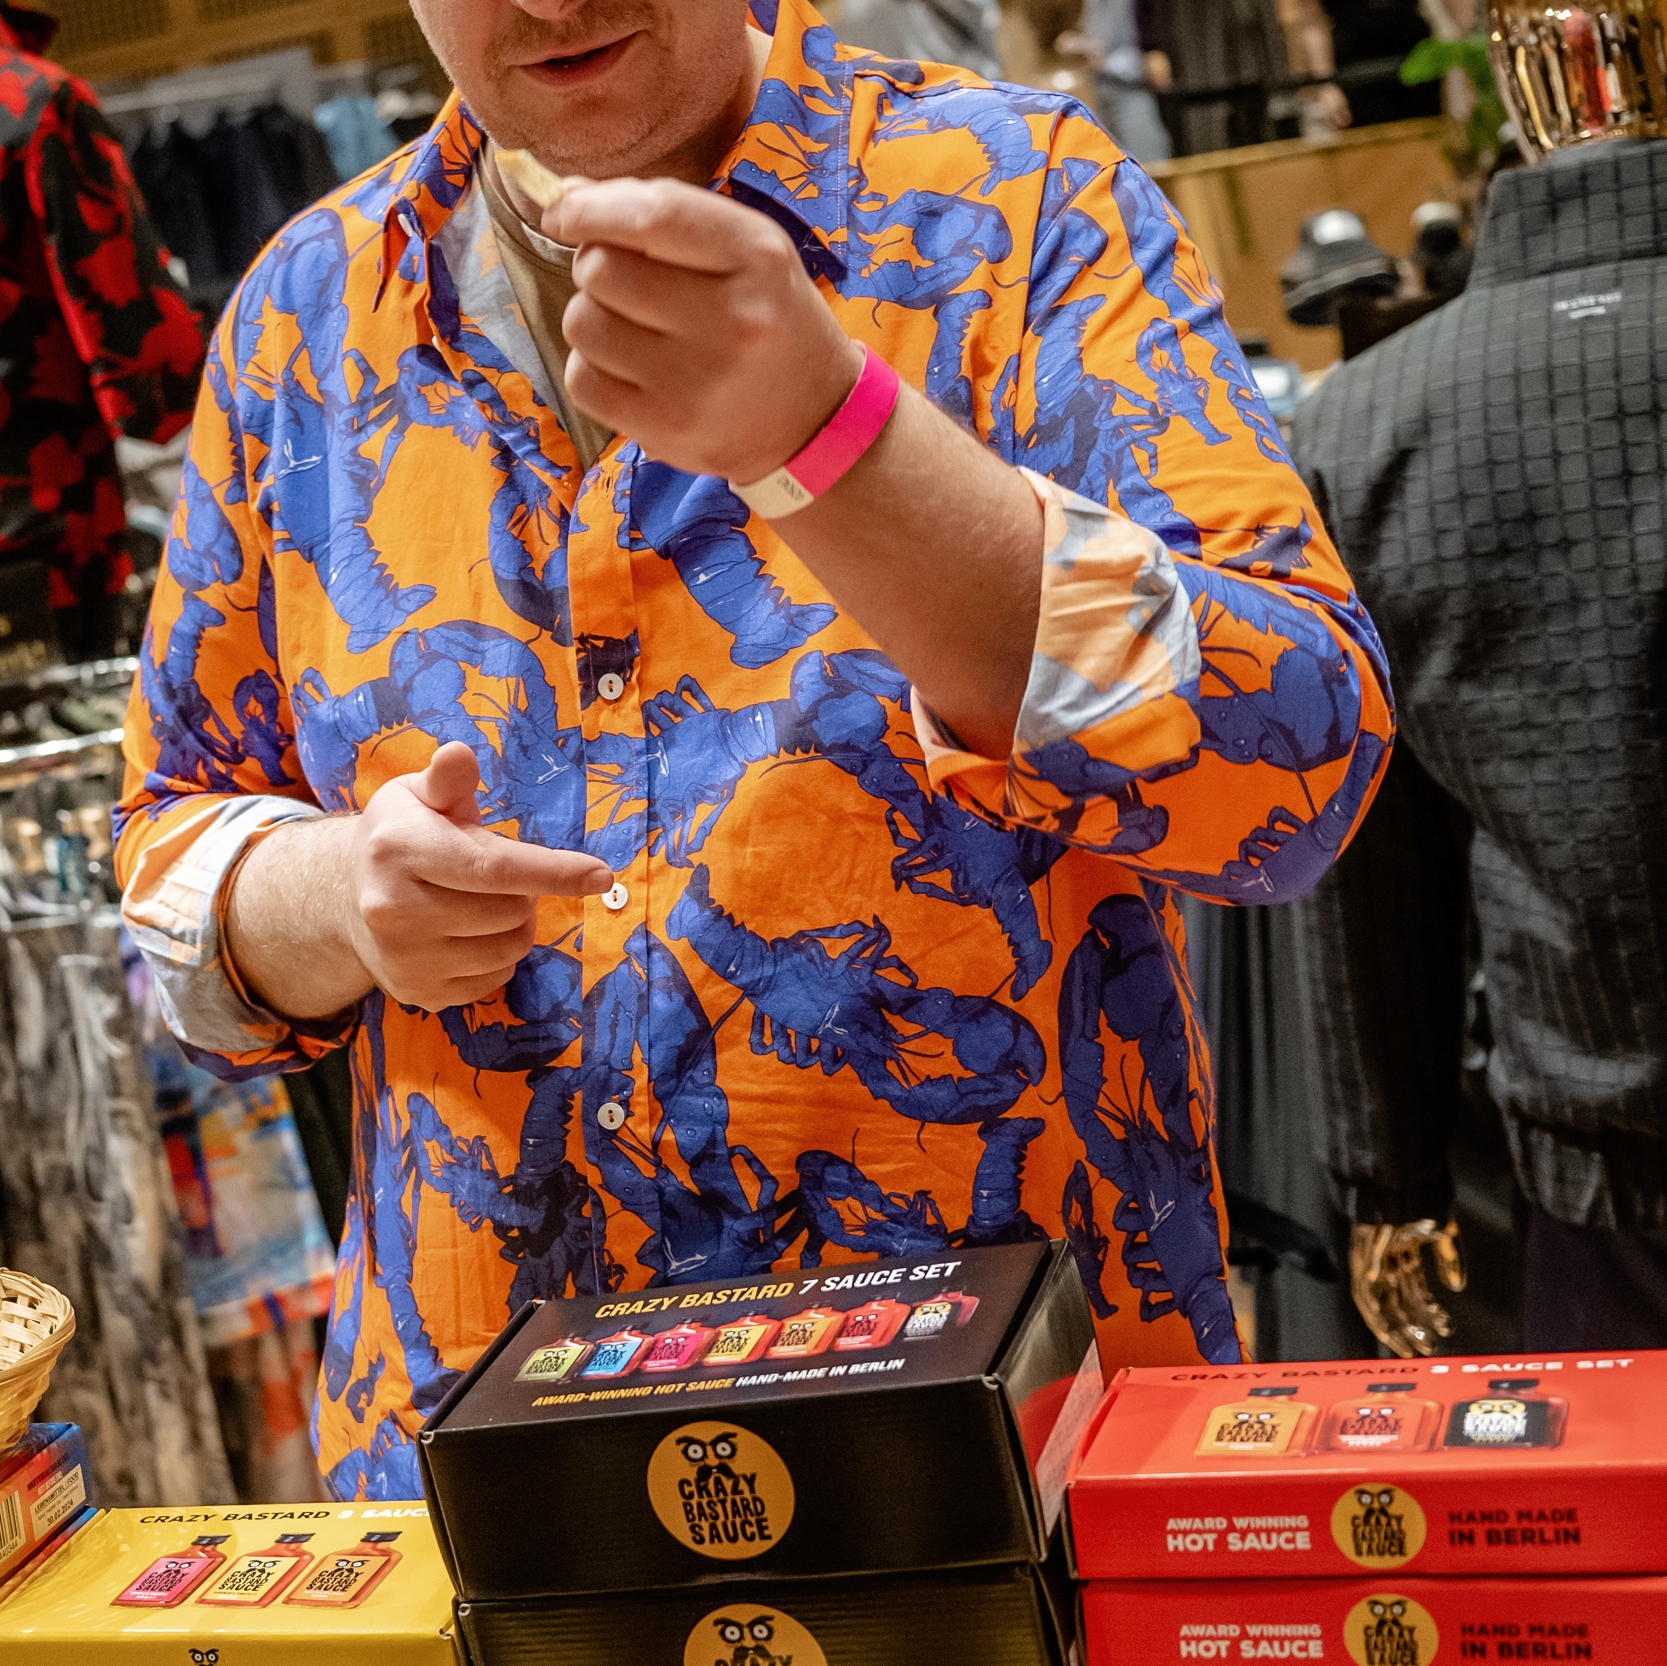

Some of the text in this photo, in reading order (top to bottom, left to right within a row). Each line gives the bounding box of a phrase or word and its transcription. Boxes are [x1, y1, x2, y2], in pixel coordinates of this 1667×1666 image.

[594, 1261, 962, 1320] CRAZY BASTARD 7 SAUCE SET
[1171, 1371, 1268, 1382] CRAZY
[1281, 1366, 1419, 1379] BASTARD
[1461, 1360, 1564, 1373] SAUCE
[1576, 1358, 1635, 1370] SET
[531, 1358, 905, 1407] AWARD-WINNING HOT SAUCE HAND-MADE IN BERLIN
[678, 1472, 757, 1500] CRAZY
[139, 1513, 218, 1524] CRAZY
[222, 1511, 330, 1522] BASTARD
[682, 1496, 765, 1523] BASTARD
[1449, 1508, 1577, 1524] HAND MADE
[689, 1517, 773, 1545] SAUCE
[1166, 1515, 1309, 1531] AWARD WINNING
[1167, 1530, 1311, 1552] HOT SAUCE
[1449, 1527, 1581, 1546] IN BERLIN
